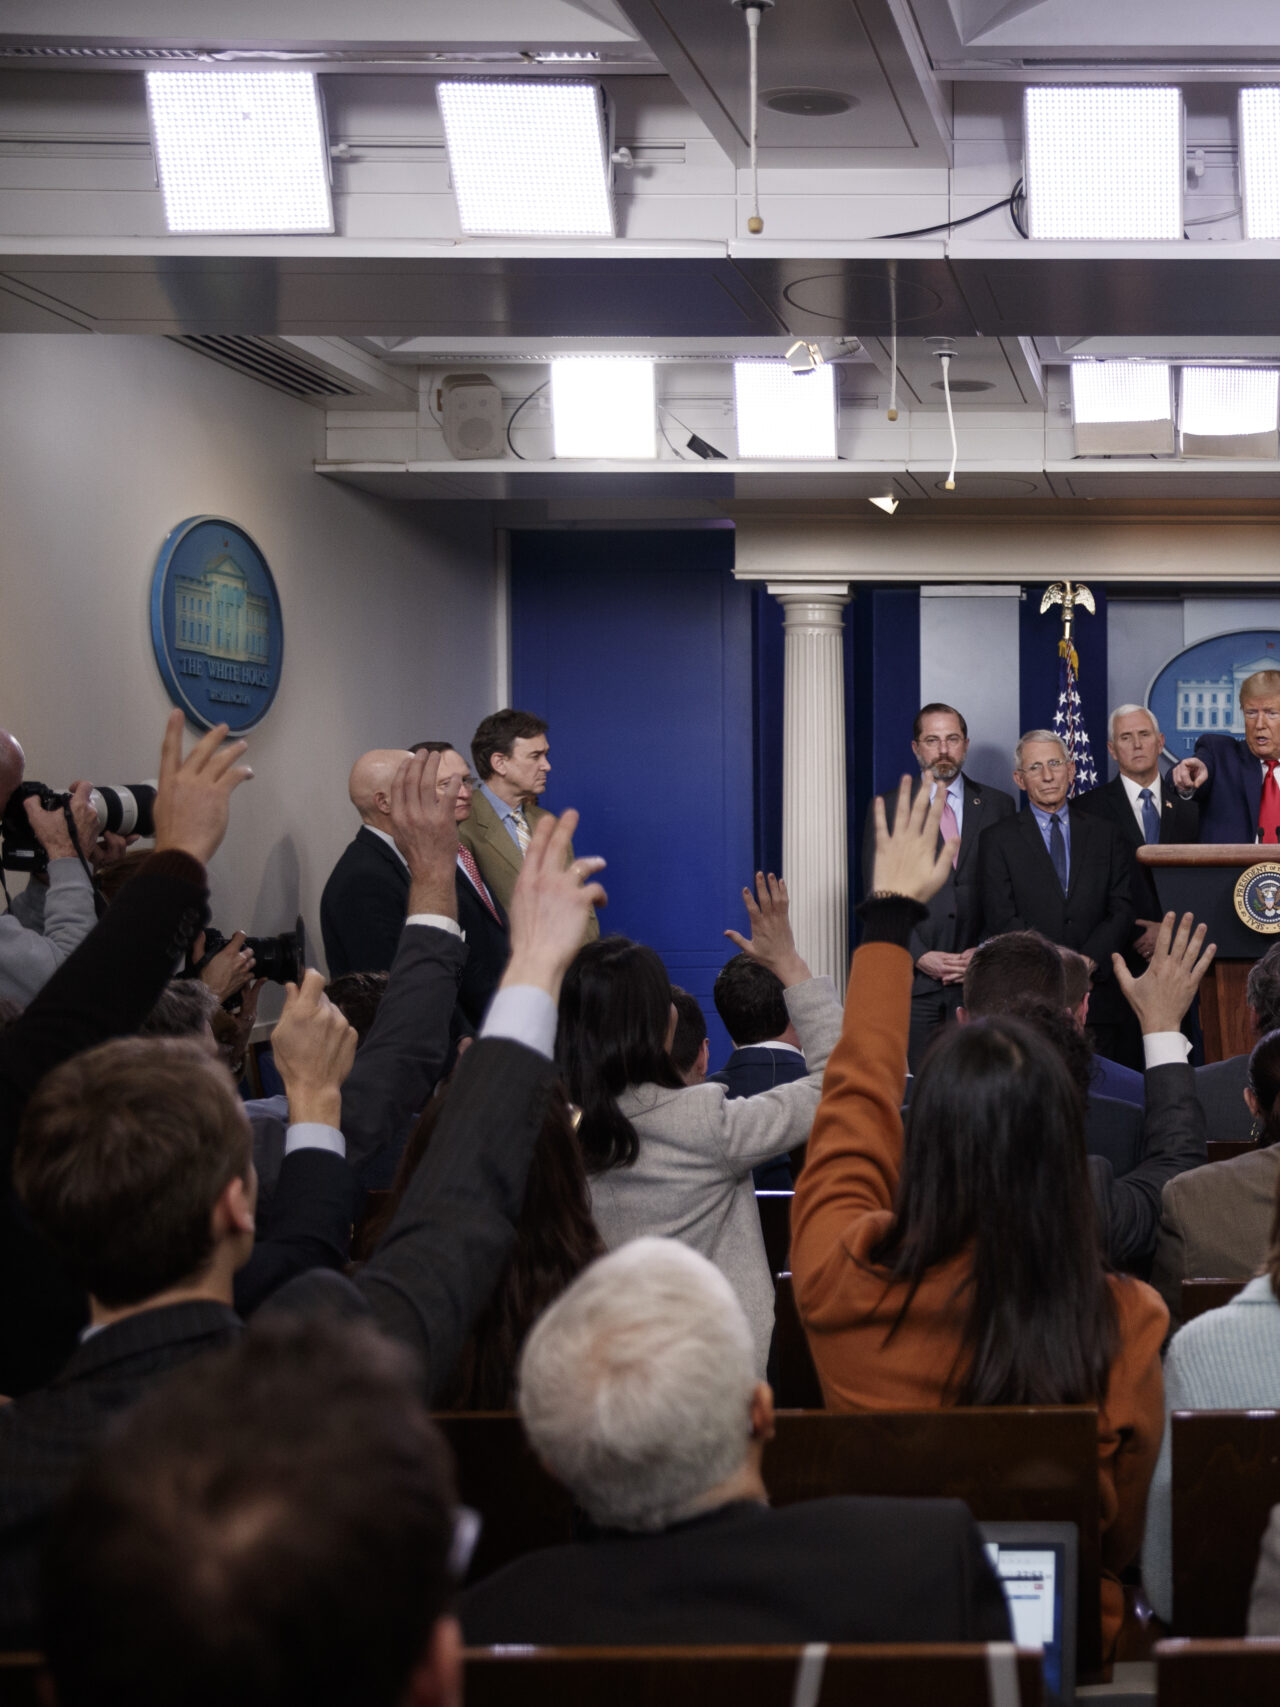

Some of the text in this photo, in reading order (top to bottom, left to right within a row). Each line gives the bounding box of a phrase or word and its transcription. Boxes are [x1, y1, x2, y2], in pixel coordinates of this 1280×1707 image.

[182, 656, 271, 687] THE WHITE HOUSE
[1237, 865, 1268, 898] PRESIDENT
[1246, 915, 1265, 931] SEAL
